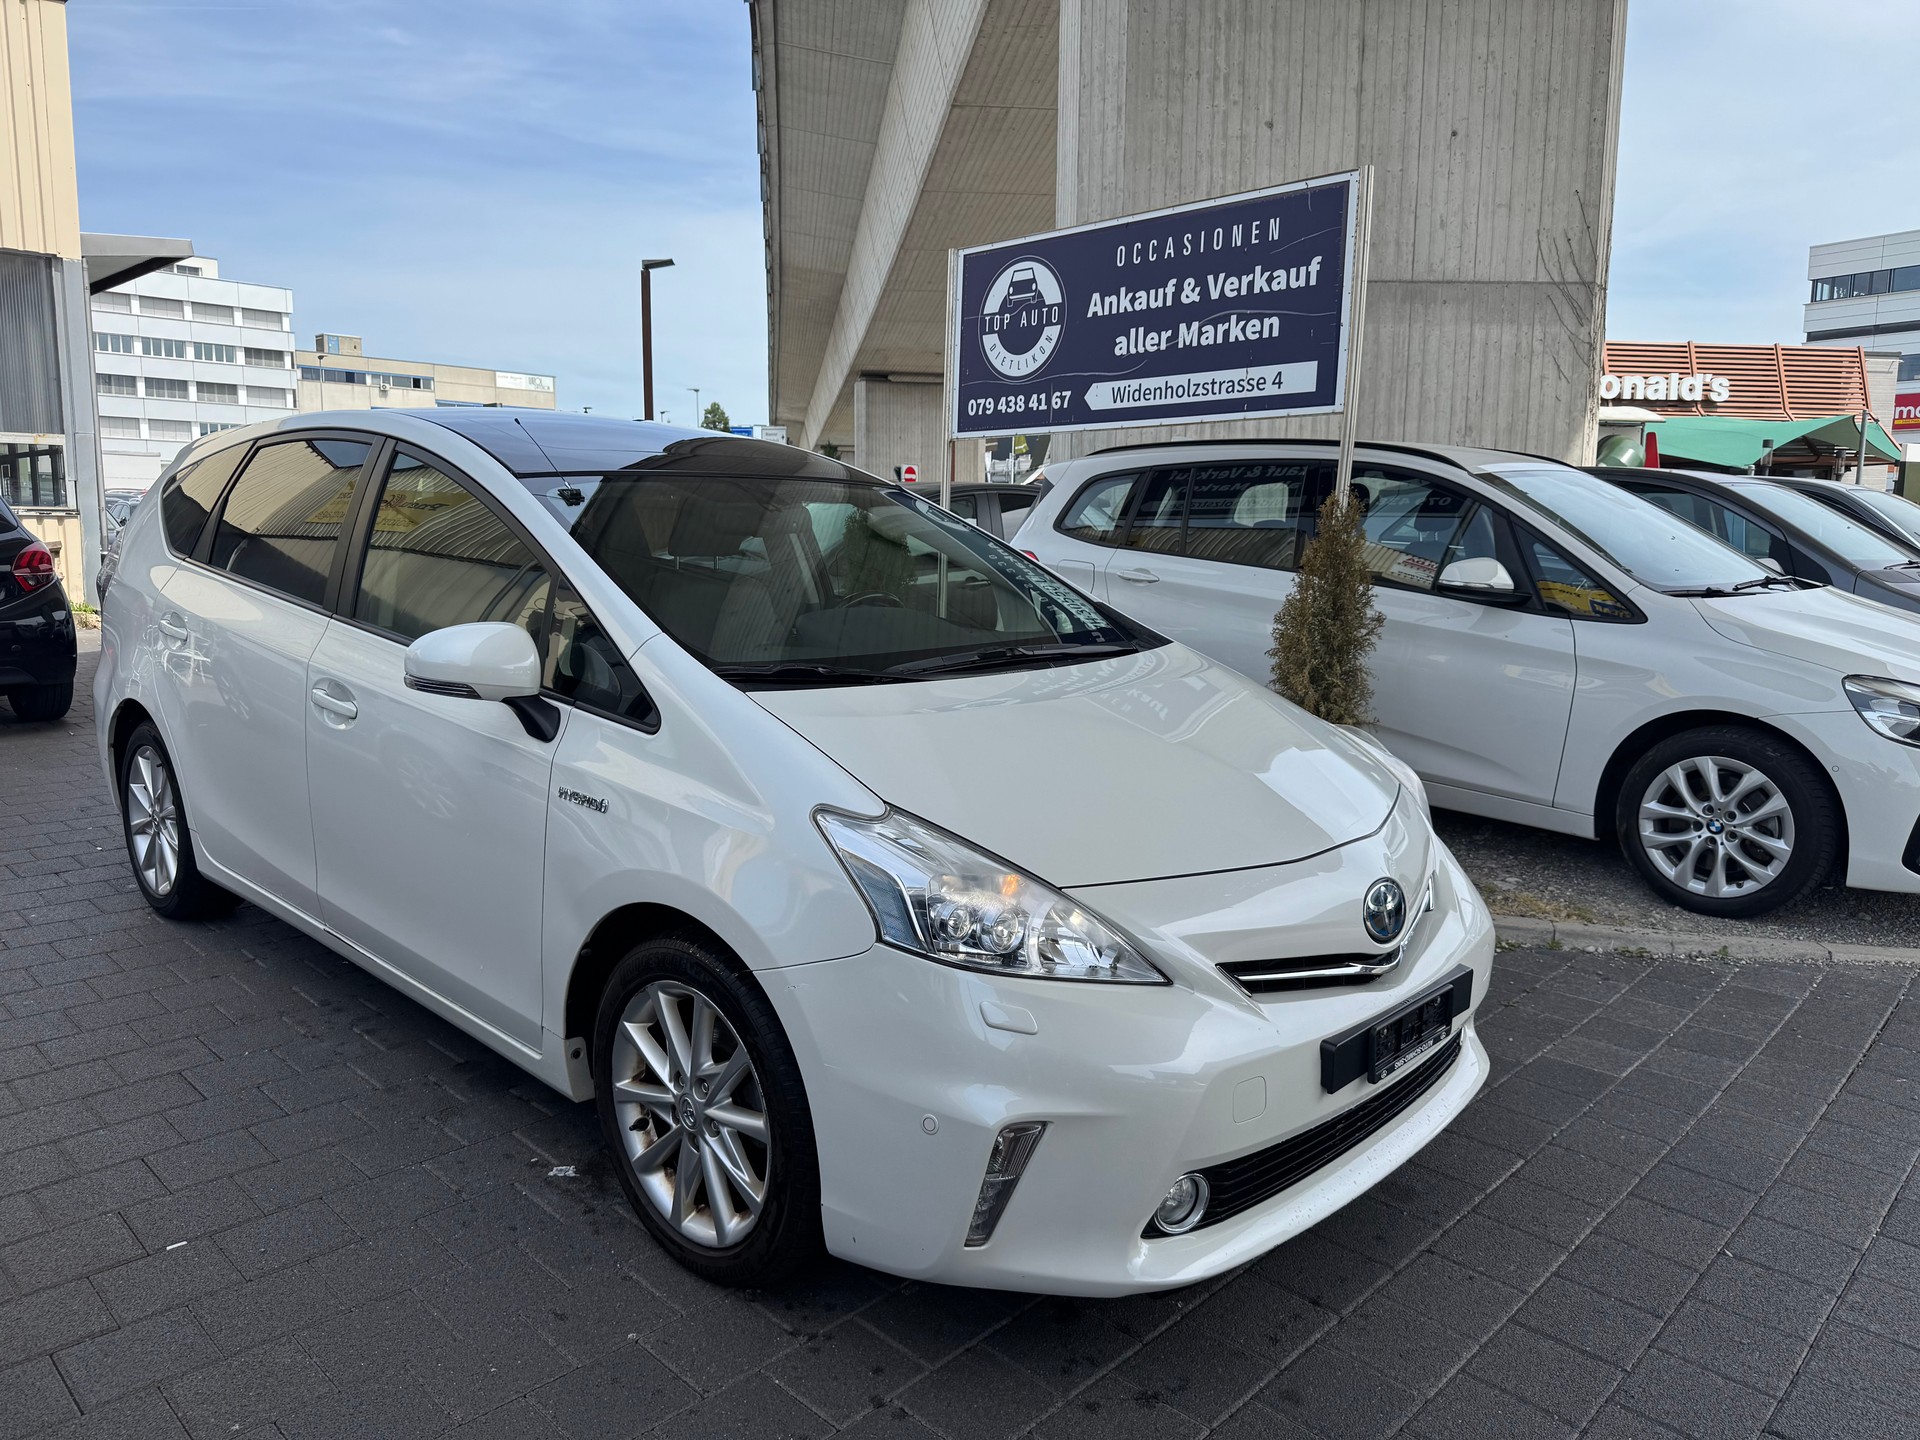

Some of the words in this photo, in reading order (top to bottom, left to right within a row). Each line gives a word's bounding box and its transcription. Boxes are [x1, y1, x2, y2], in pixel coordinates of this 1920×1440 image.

[1116, 217, 1280, 267] OCCASIONEN
[1086, 278, 1177, 318] Ankauf
[1180, 277, 1200, 304] &
[1207, 256, 1322, 300] Verkauf
[985, 313, 1010, 332] TOP
[1020, 306, 1058, 327] AUTO
[1113, 326, 1172, 356] aller
[1178, 314, 1280, 349] Marken
[989, 335, 1053, 370] DIETLIKON
[967, 397, 995, 416] 079
[997, 395, 1025, 414] 438
[1028, 393, 1048, 412] 41
[1051, 391, 1072, 410] 67
[1111, 375, 1266, 405] Widenholzstrasse
[1271, 371, 1284, 389] 4
